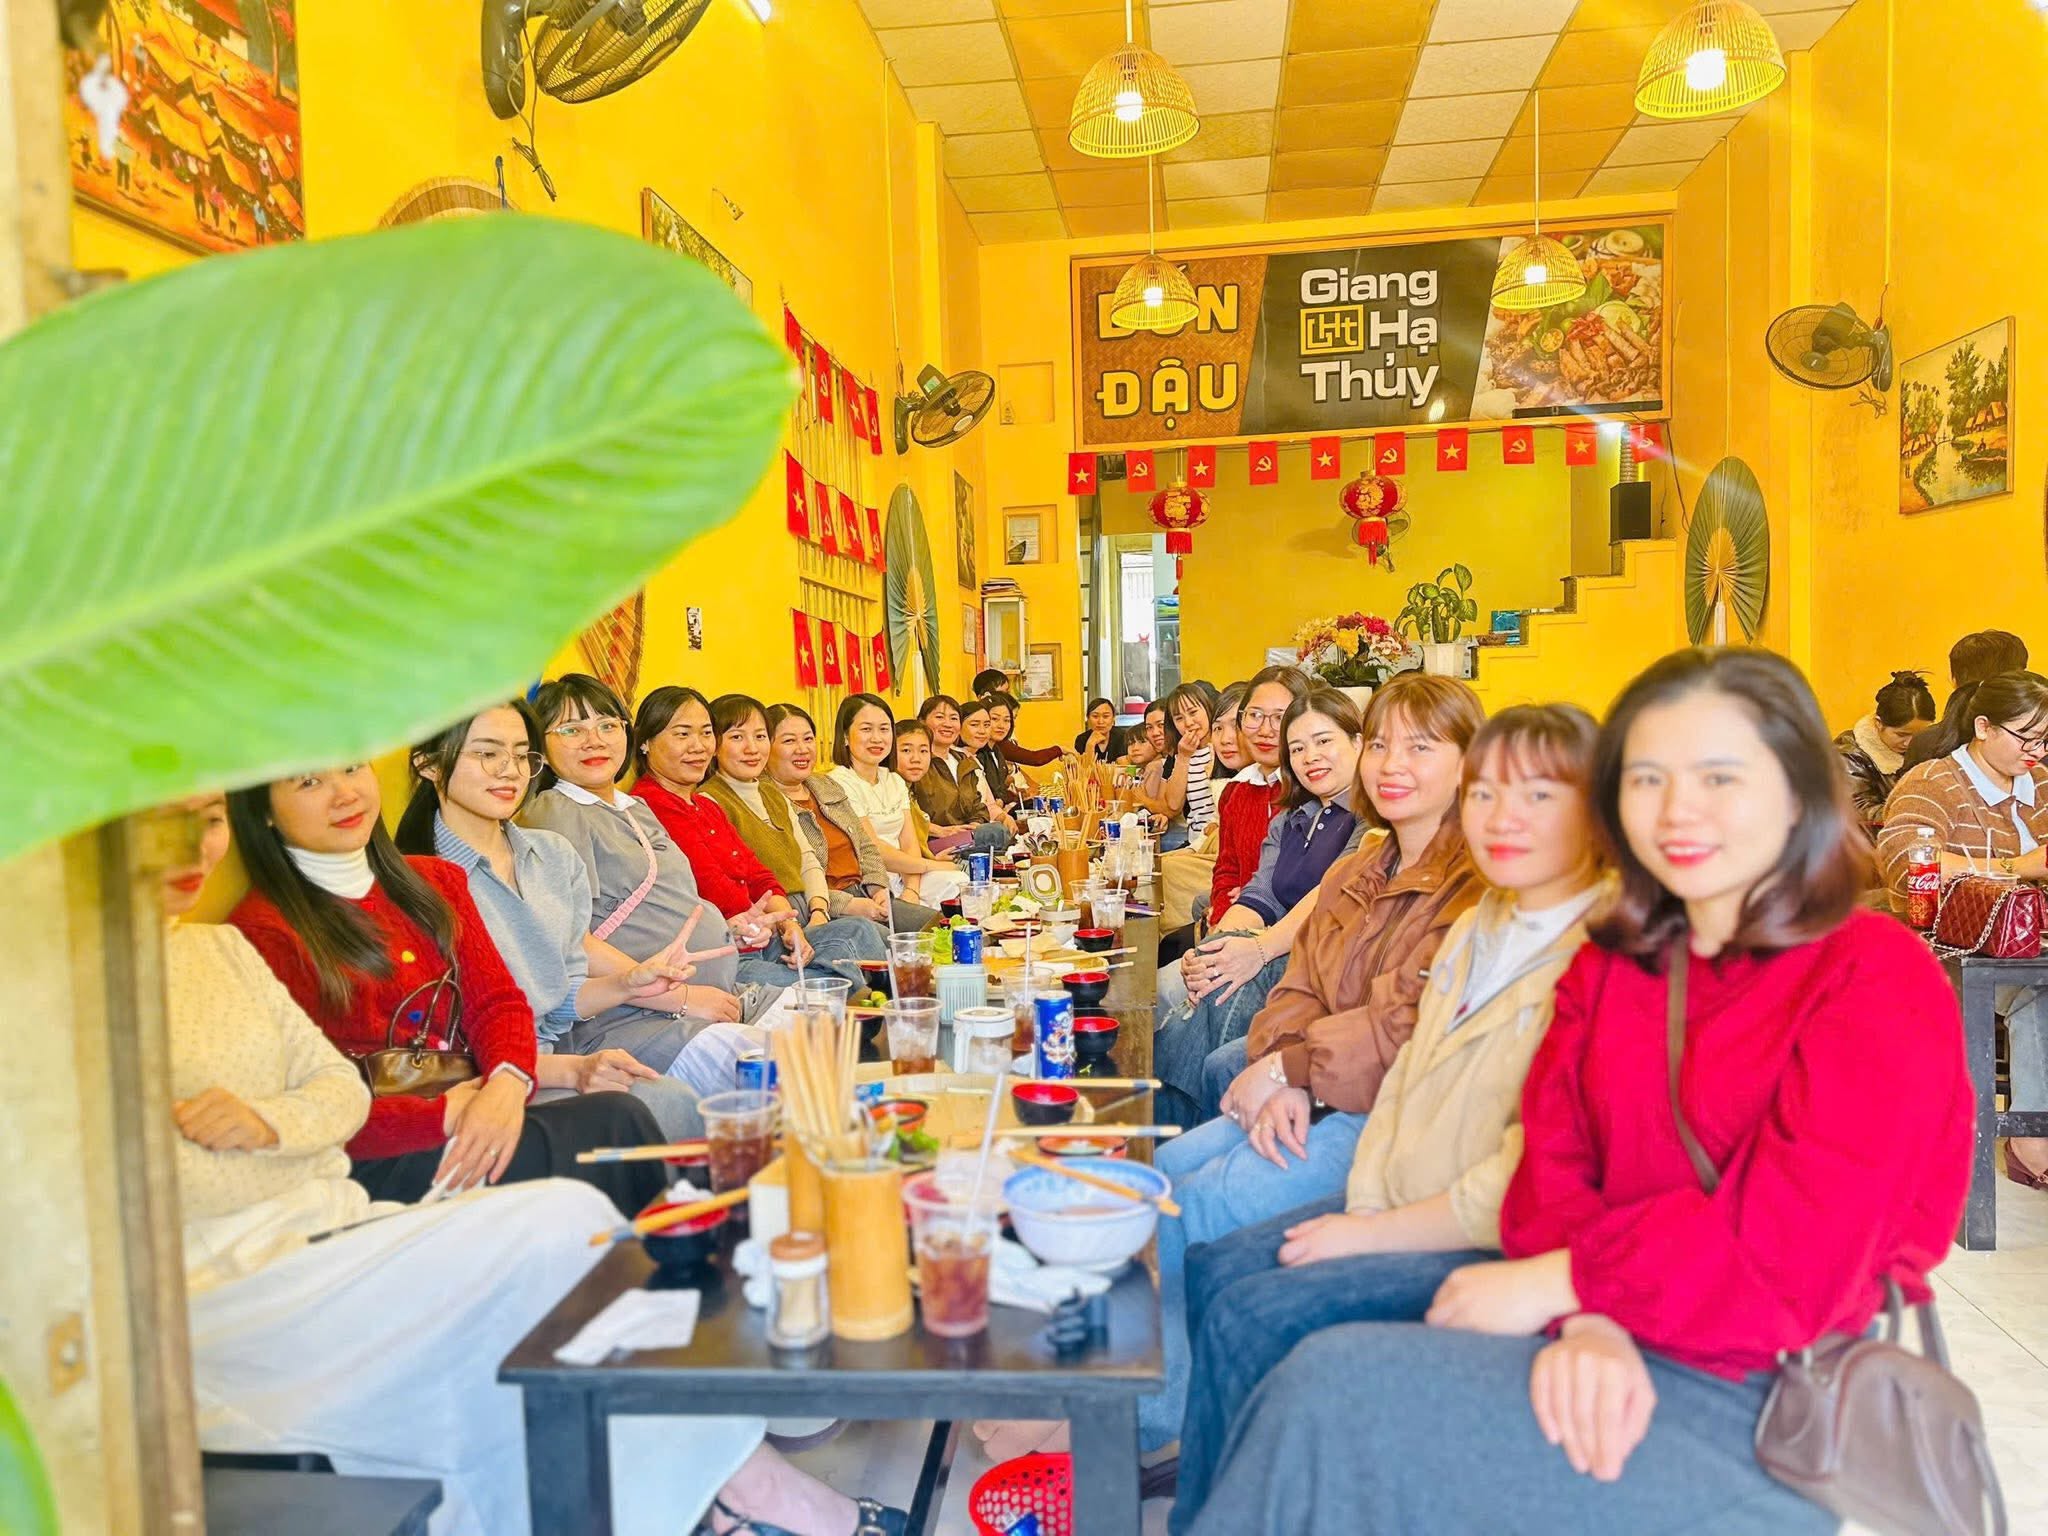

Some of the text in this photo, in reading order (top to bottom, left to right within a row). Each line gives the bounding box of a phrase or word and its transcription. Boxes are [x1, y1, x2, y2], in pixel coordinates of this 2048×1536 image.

[1301, 267, 1438, 307] Giang
[1369, 309, 1438, 354] Hạ
[1096, 357, 1238, 429] ĐẬU
[1300, 352, 1440, 407] Thủy
